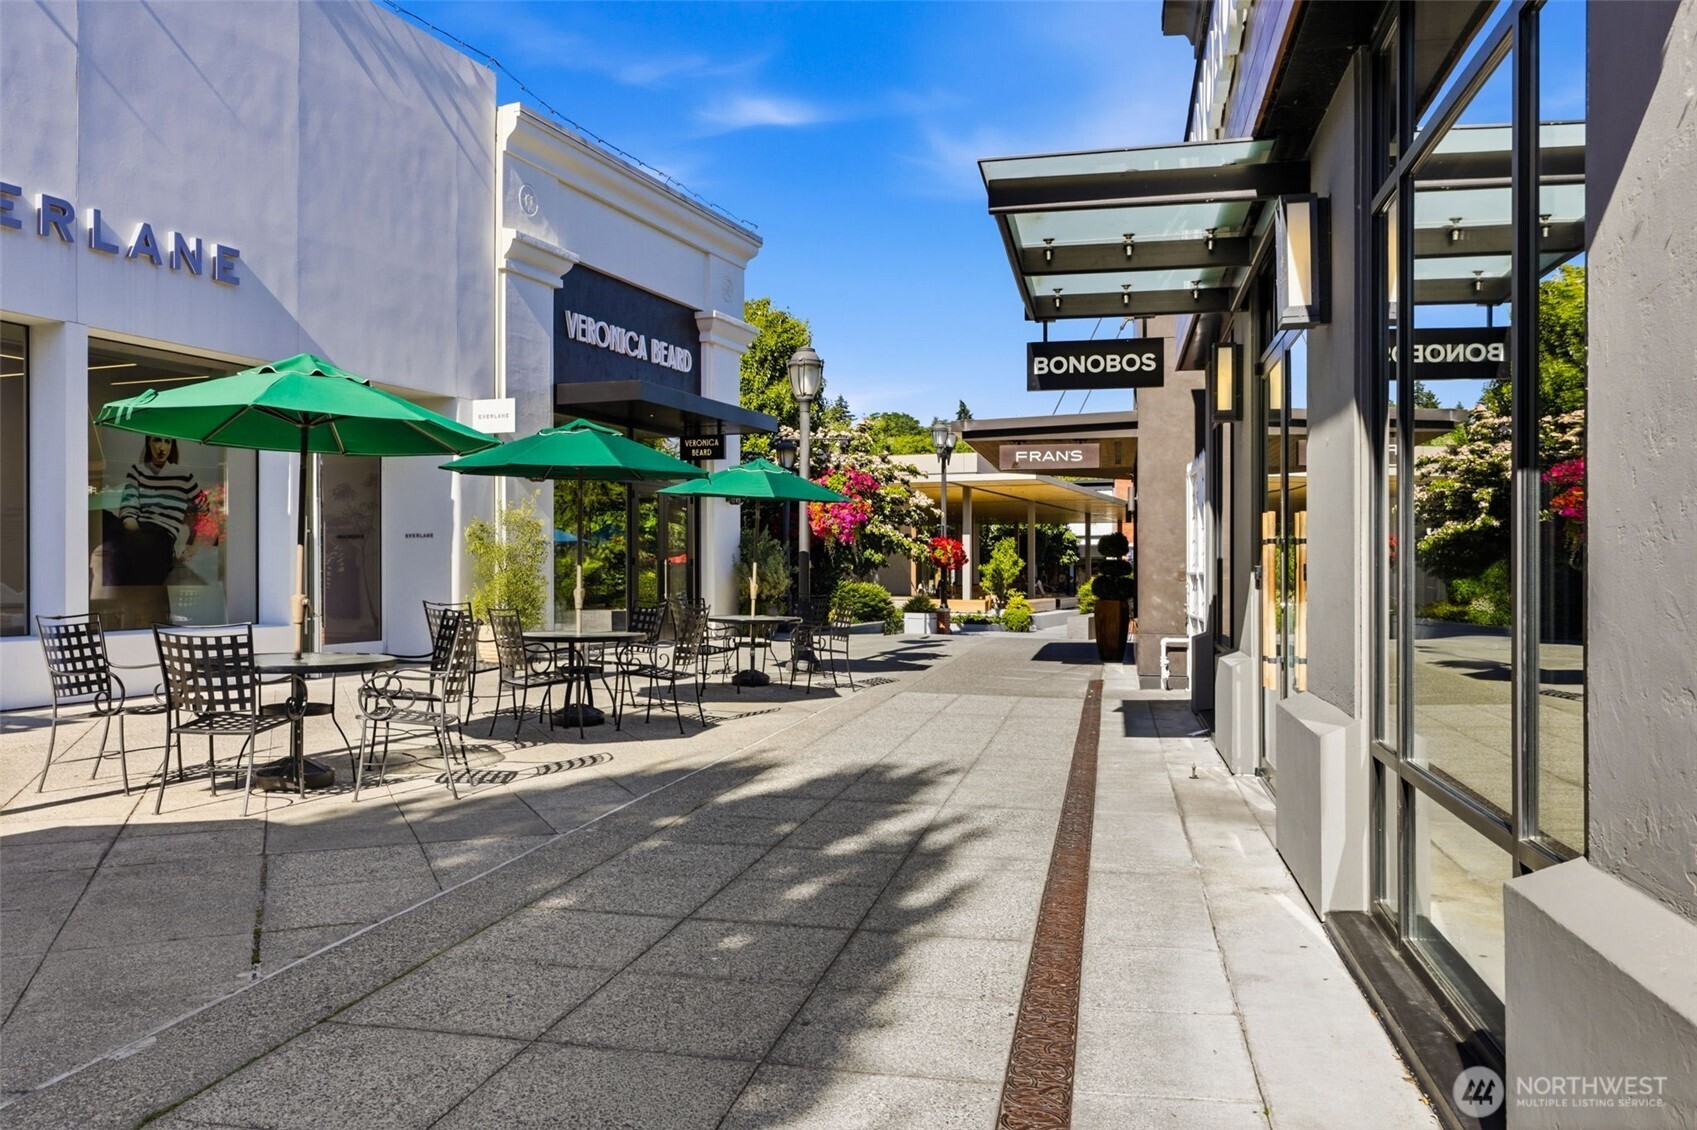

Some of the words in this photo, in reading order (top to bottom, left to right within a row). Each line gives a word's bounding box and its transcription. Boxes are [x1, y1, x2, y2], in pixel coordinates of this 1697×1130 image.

[564, 309, 648, 361] VERONICA
[650, 338, 693, 373] BEARD
[1033, 353, 1157, 375] BONOBOS
[478, 412, 510, 420] EVERLANE
[684, 438, 720, 447] VERONICA
[691, 448, 713, 457] BEARD
[1015, 450, 1084, 462] FRAN'S
